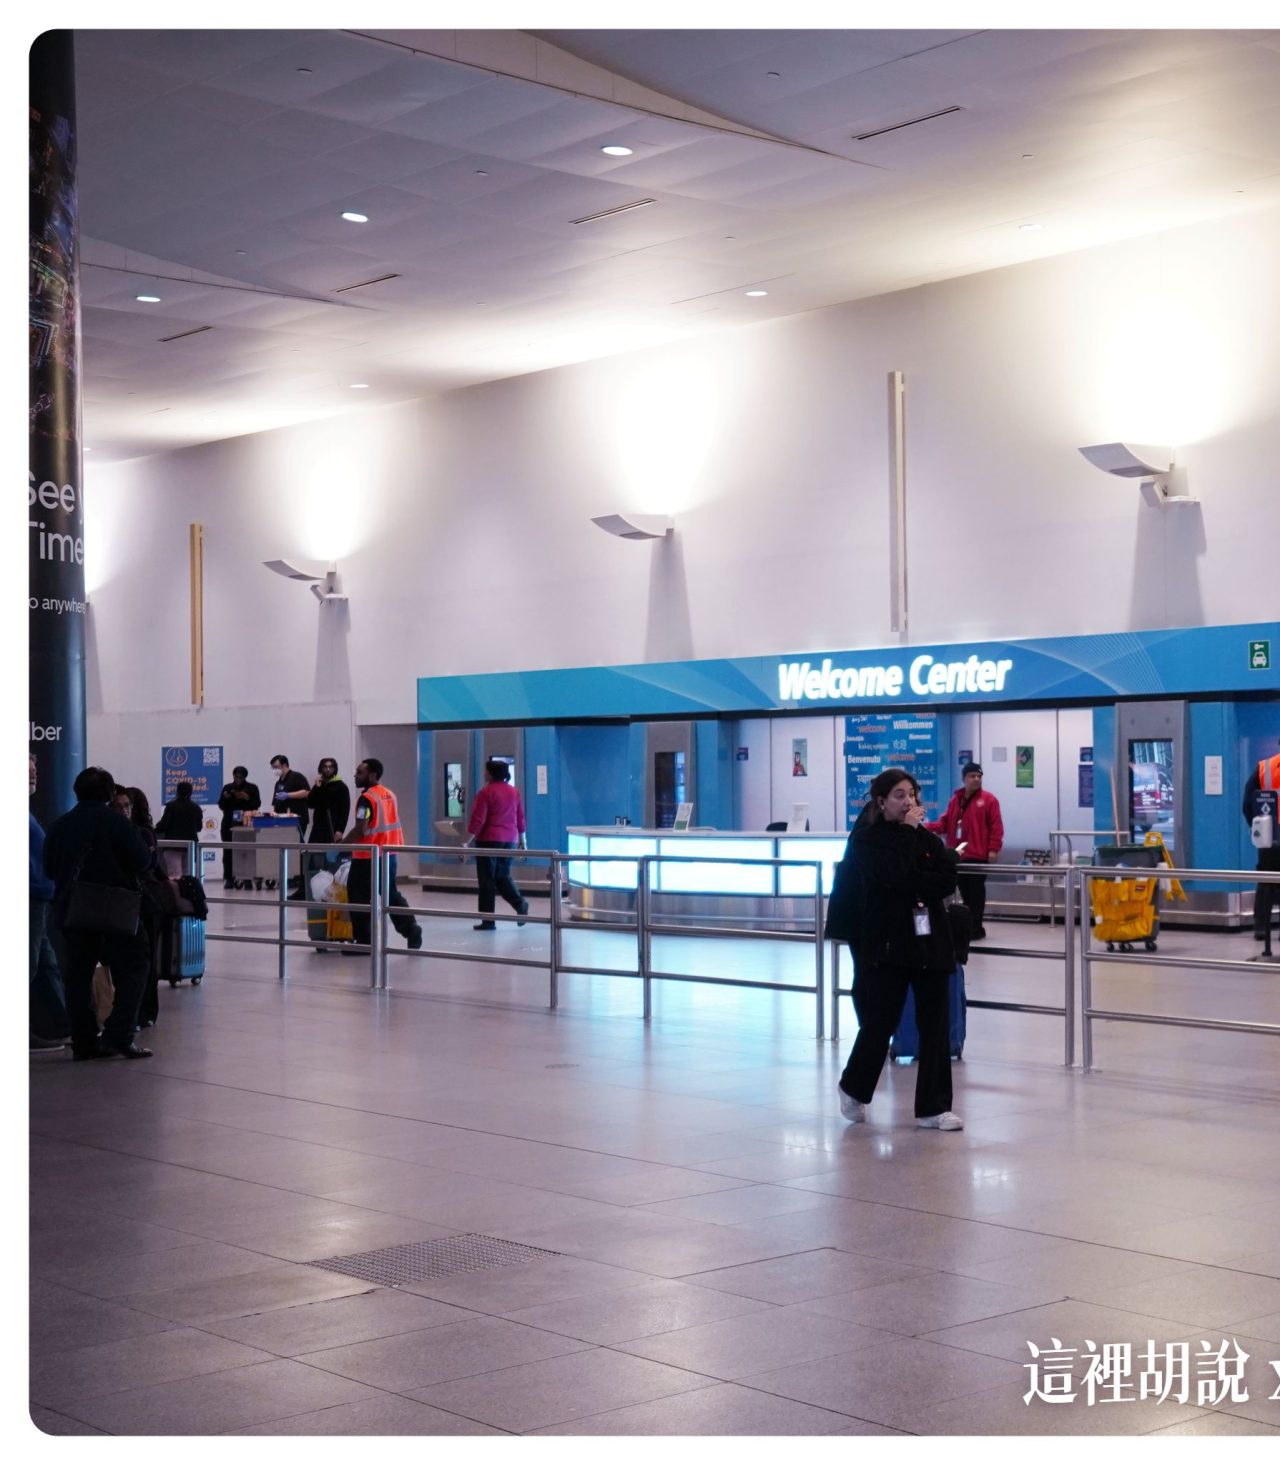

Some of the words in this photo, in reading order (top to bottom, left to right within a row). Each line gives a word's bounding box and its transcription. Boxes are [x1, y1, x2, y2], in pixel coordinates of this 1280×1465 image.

[778, 658, 904, 700] Welcome
[909, 654, 1013, 696] Center
[893, 719, 934, 730] Willkommen
[29, 721, 62, 741] ber
[847, 754, 881, 764] Benvenuto
[166, 769, 188, 777] Keep
[166, 776, 208, 785] COVID-19
[166, 784, 209, 794] grded.
